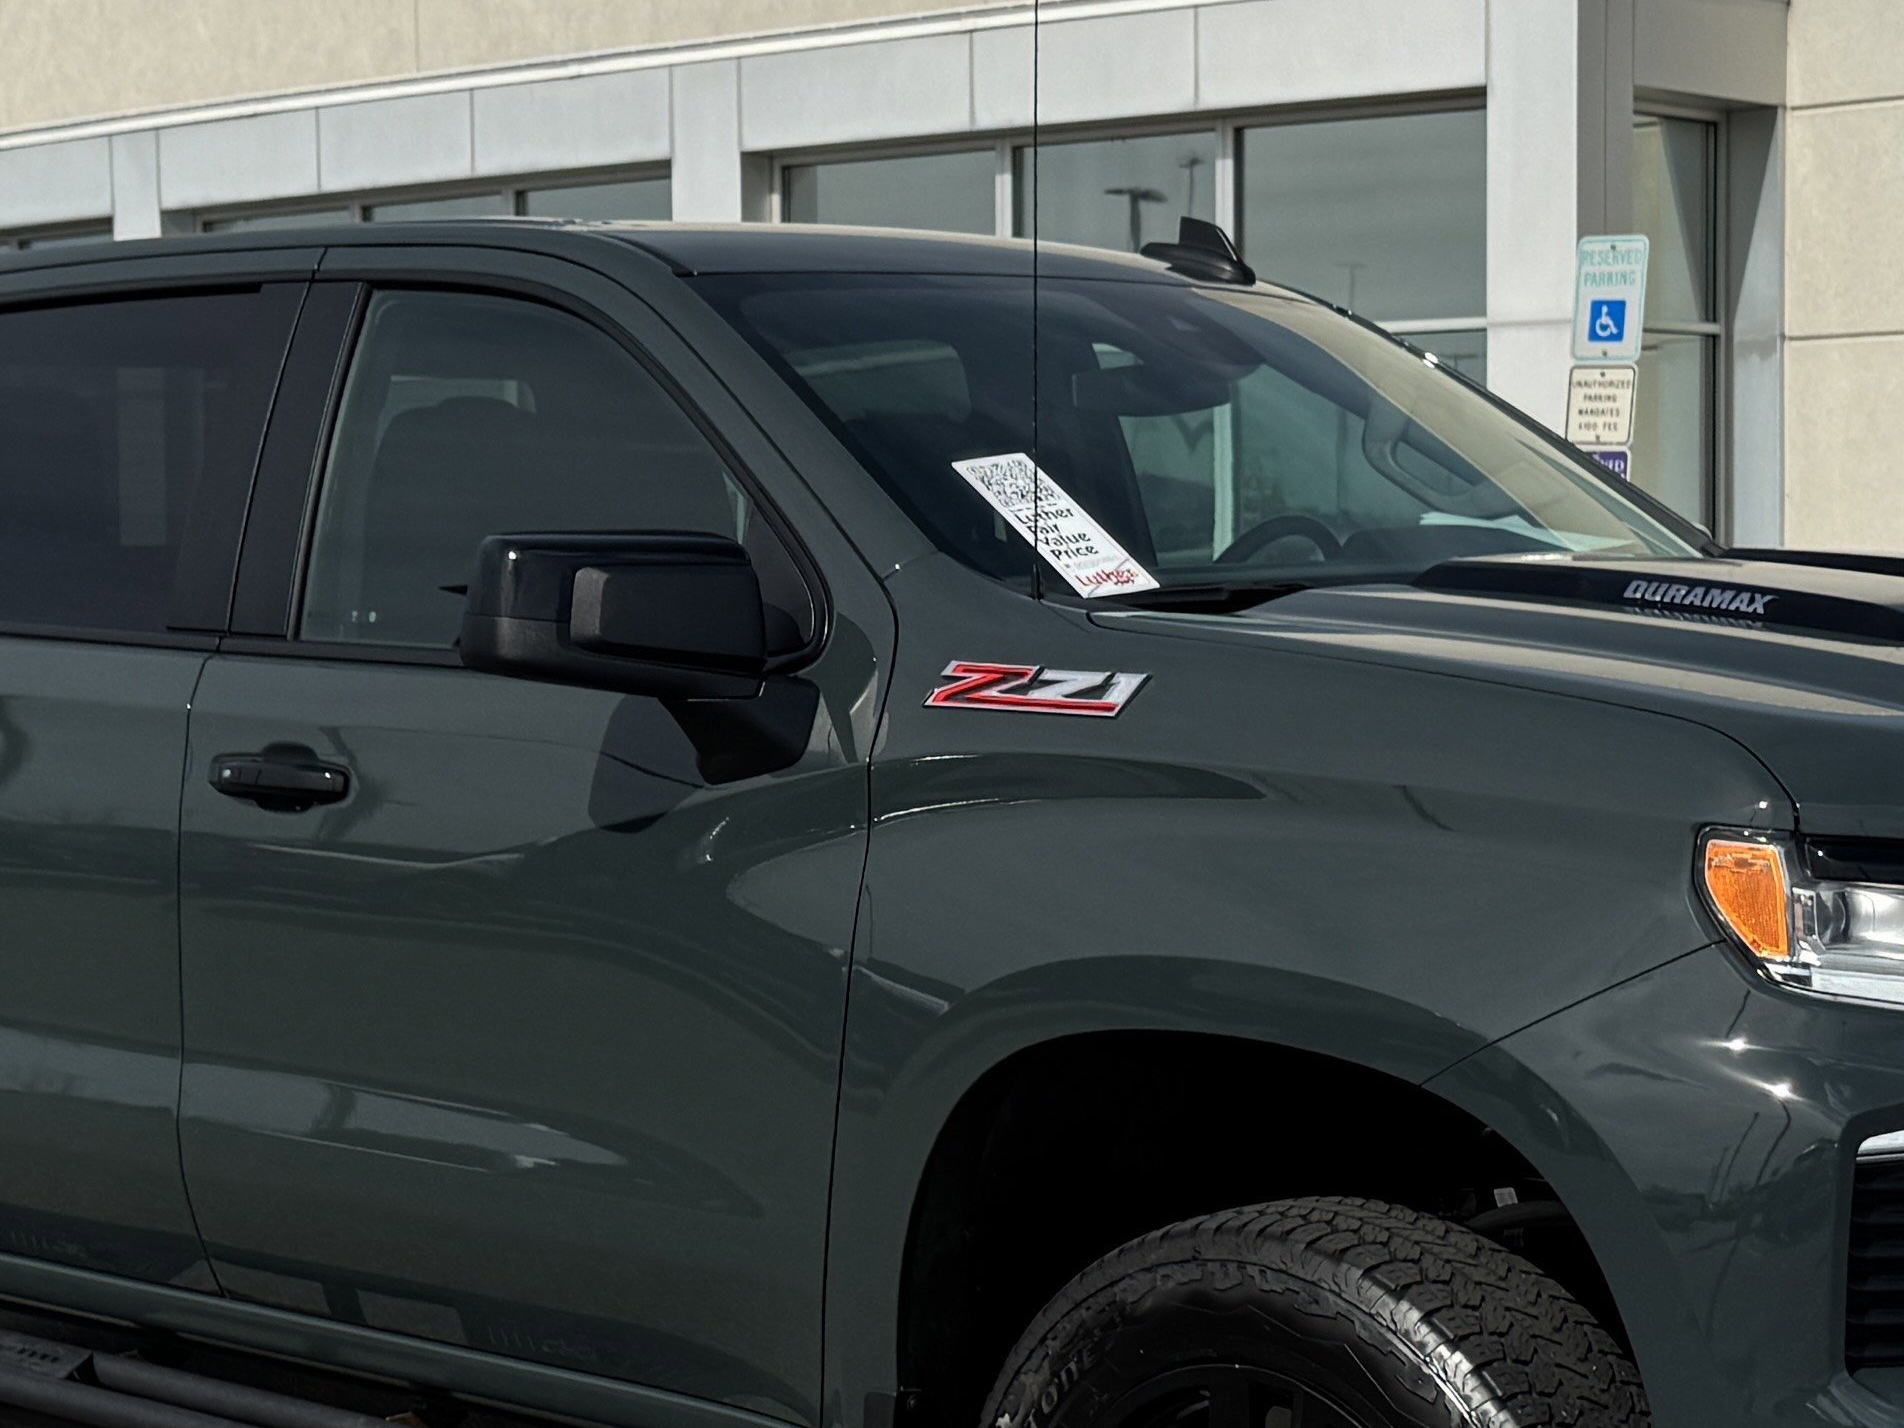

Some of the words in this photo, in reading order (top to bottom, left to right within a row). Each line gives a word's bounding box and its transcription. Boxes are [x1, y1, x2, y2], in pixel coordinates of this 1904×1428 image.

[1581, 249, 1643, 266] RESERVED
[1584, 271, 1635, 287] PARKING
[1035, 531, 1092, 549] Value
[1049, 543, 1099, 562] Price
[1623, 579, 1779, 614] DURAMAX
[923, 660, 1152, 717] Z71
